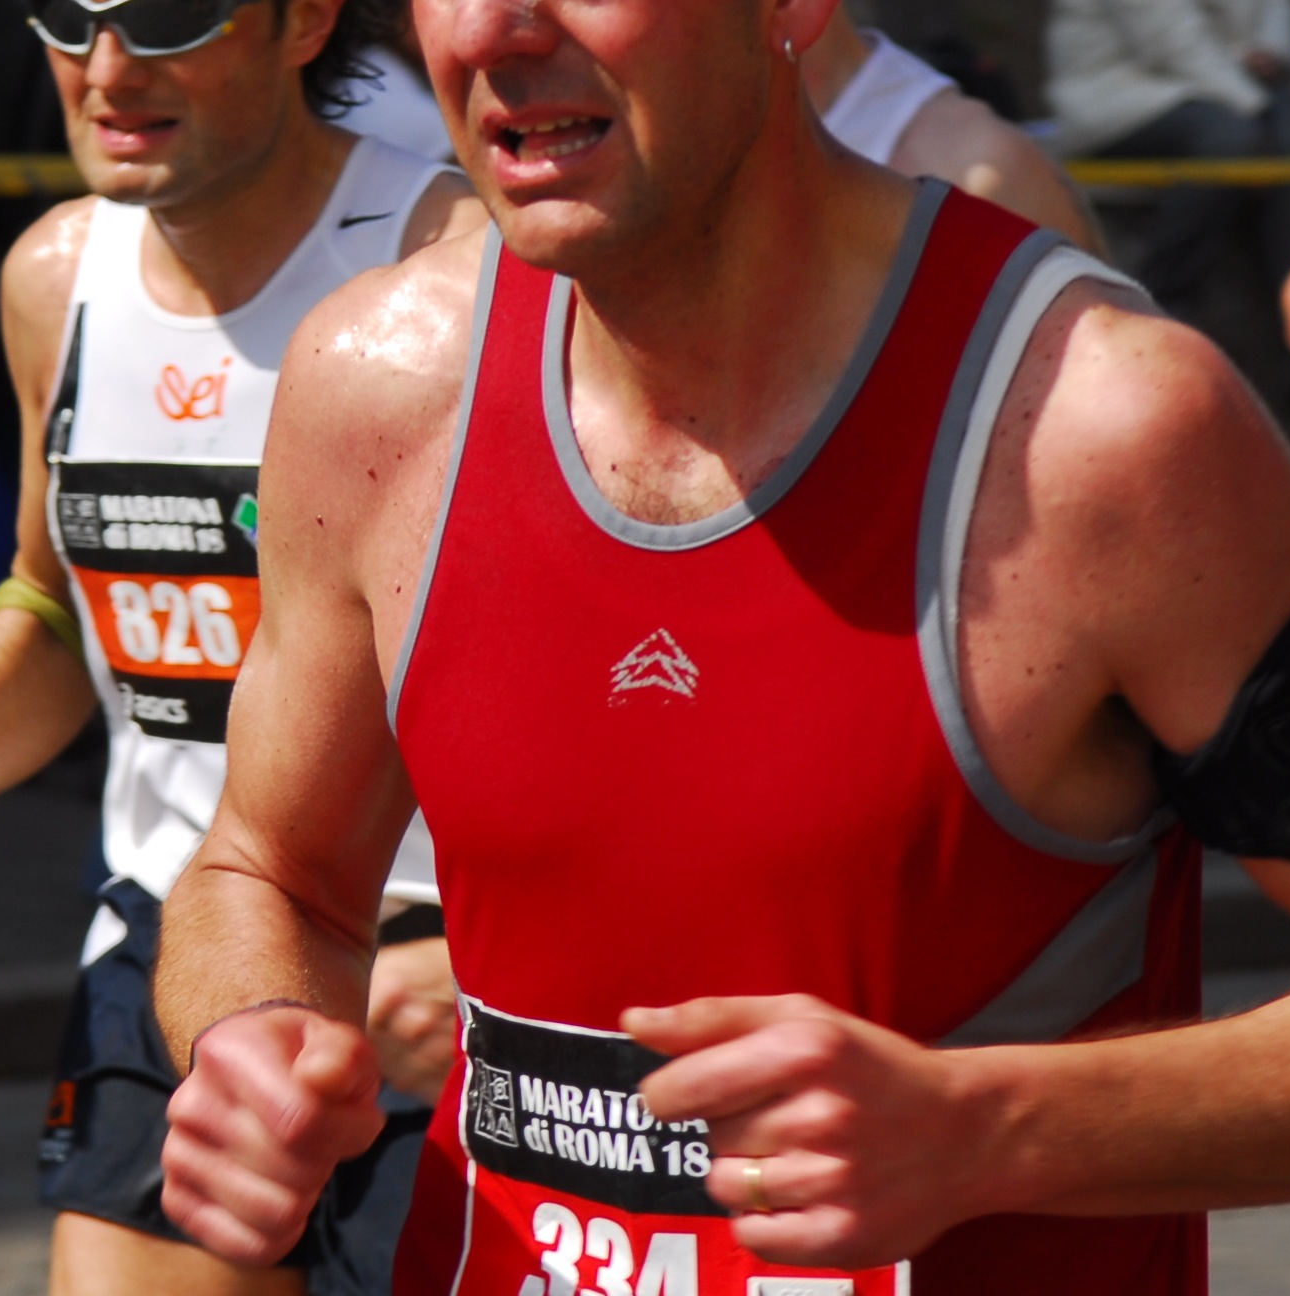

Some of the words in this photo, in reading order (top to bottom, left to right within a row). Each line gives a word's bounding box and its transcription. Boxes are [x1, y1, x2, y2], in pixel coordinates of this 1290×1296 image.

[154, 357, 234, 421] Sei
[109, 581, 242, 667] 826
[520, 1075, 710, 1135] MARATO
[524, 1117, 554, 1154] di
[554, 1124, 655, 1172] ROMA
[662, 1140, 712, 1177] 18
[518, 1202, 699, 1296] 334
